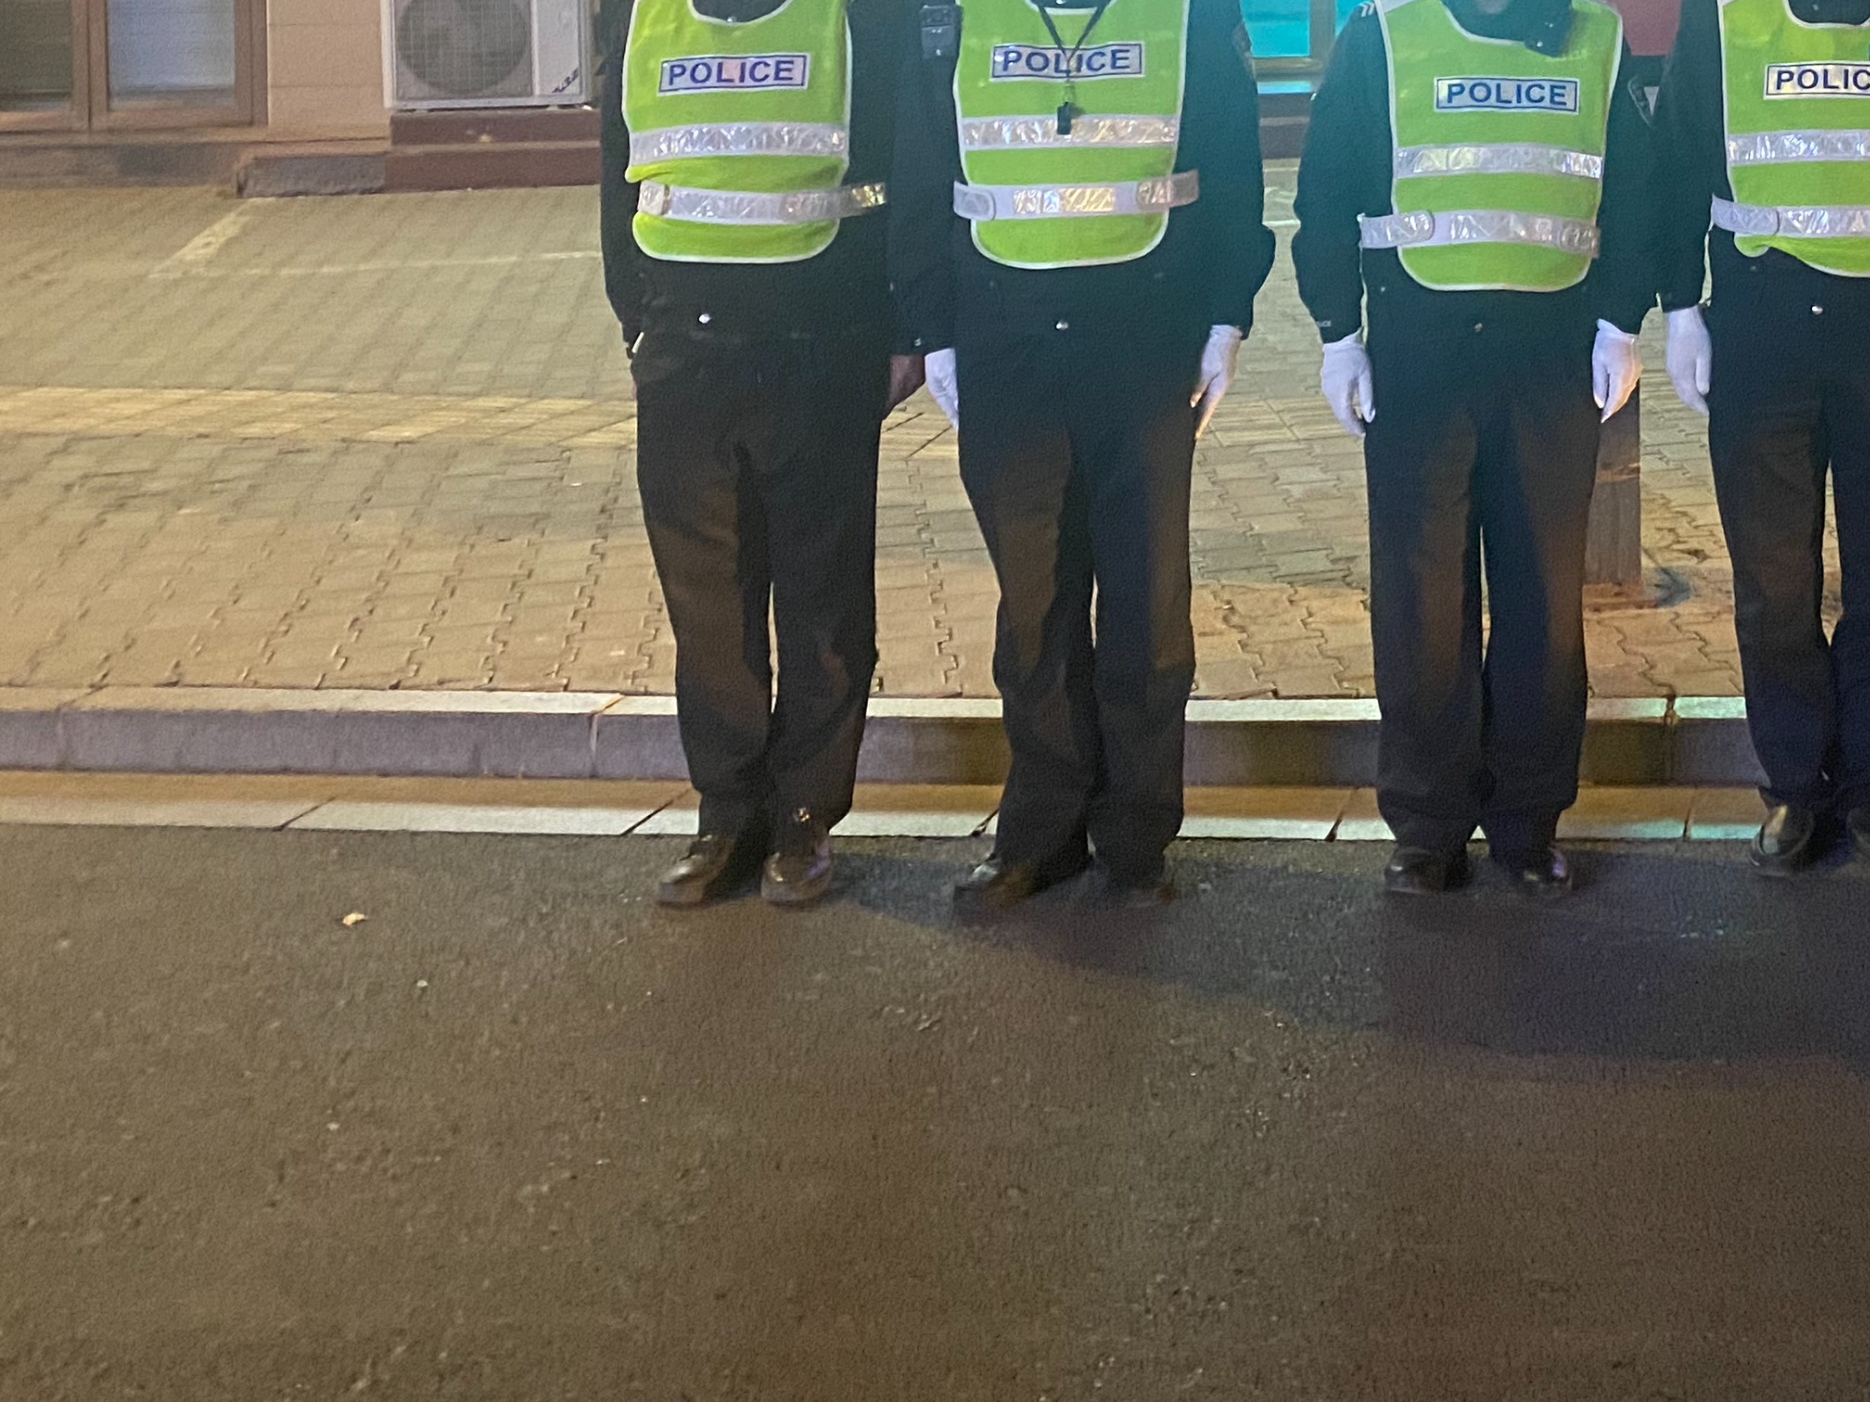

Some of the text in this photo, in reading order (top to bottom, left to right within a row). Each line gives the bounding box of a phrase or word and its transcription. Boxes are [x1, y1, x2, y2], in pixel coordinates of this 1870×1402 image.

[669, 60, 794, 85] POLICE
[1002, 49, 1130, 73] POLICE
[1446, 82, 1569, 108] POLICE
